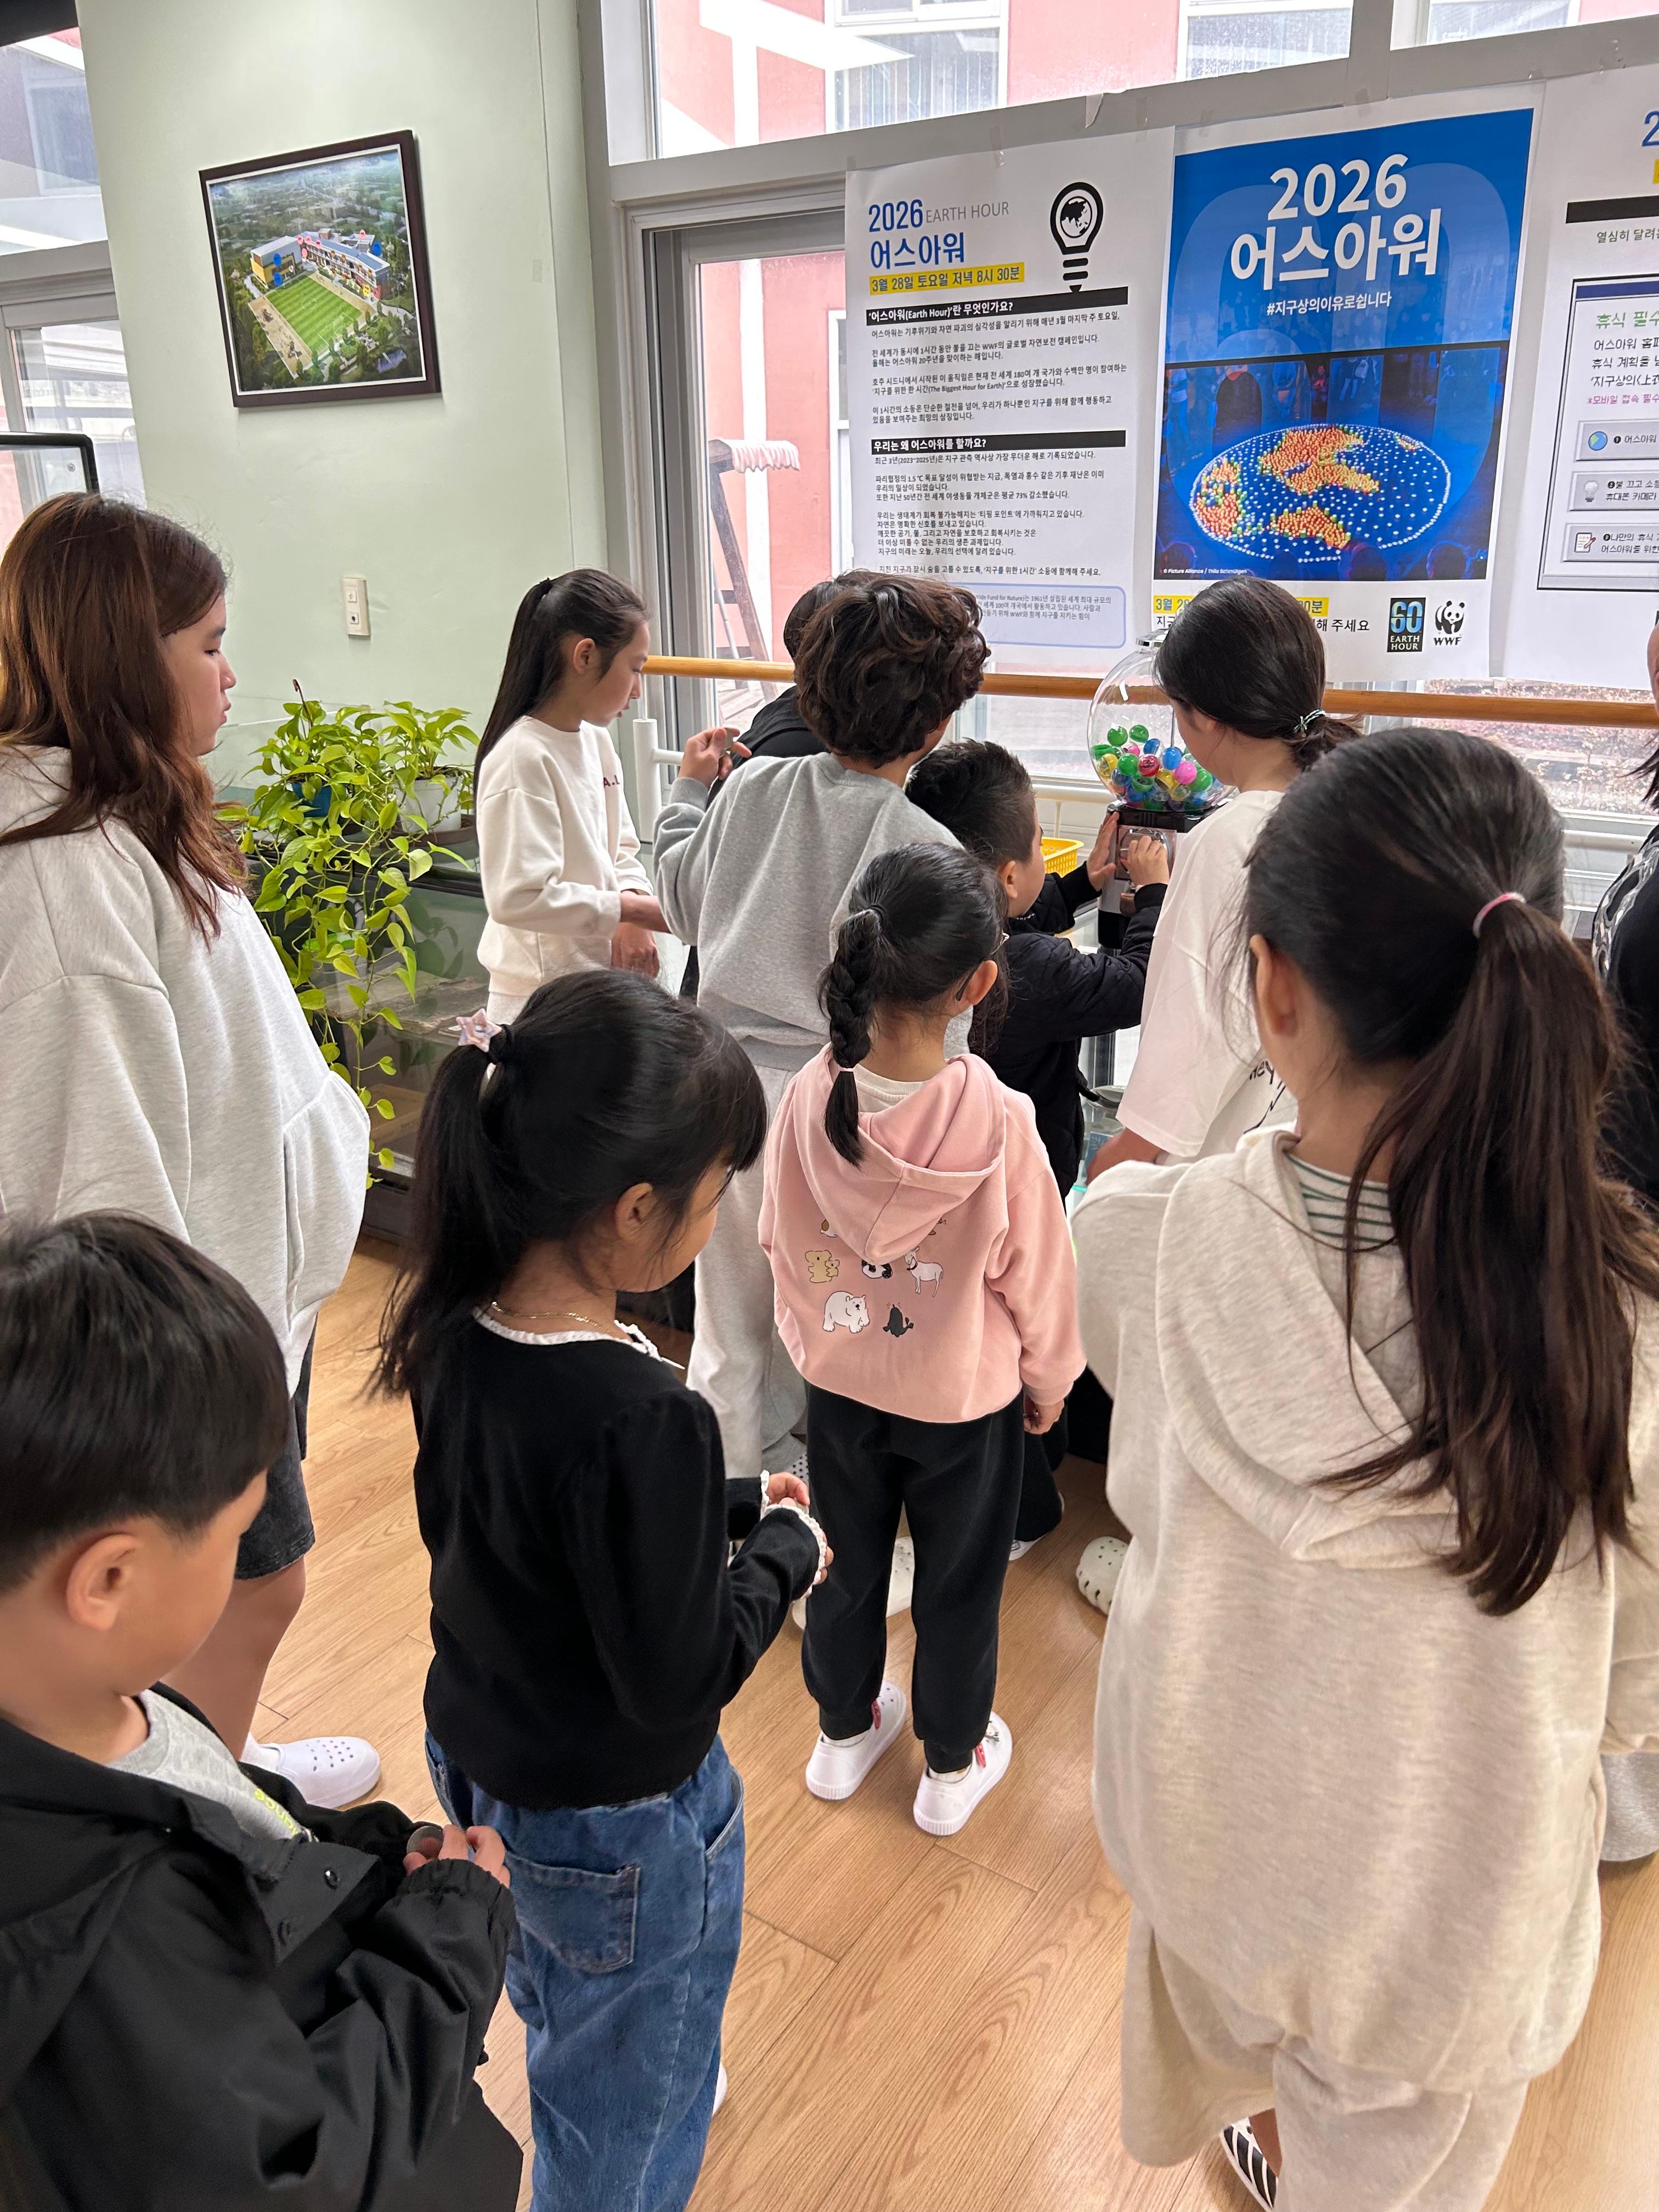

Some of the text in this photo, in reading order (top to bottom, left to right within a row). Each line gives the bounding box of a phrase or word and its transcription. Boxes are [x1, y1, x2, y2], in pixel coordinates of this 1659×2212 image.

[1268, 154, 1408, 221] 2026
[868, 199, 1009, 232] 2026 EARTH HOUR
[1597, 230, 1629, 243] 열심히
[871, 232, 964, 269] 어스아워
[1231, 208, 1442, 291] 어스아워
[872, 266, 1019, 291] 3월 28일 토요일 저녁 8시 30분
[963, 301, 1013, 315] 무엇인가요?
[1267, 291, 1392, 316] #지구상의이유로쉽니다
[871, 328, 903, 338] 어스아워는
[905, 325, 938, 336] 기후위기와
[939, 324, 951, 334] 자연
[974, 320, 1001, 331] 심각성을
[1003, 318, 1024, 329] 알리기
[1025, 318, 1039, 328] 위해
[1041, 316, 1054, 326] 매년
[1056, 315, 1065, 325] 3월
[1068, 313, 1088, 324] 마지막
[1088, 312, 1096, 323] 주
[1096, 311, 1119, 323] 토요일,
[1596, 312, 1626, 329] 휴식
[872, 349, 878, 358] 전
[879, 348, 899, 357] 세계가
[900, 346, 919, 356] 동시에
[920, 345, 937, 354] 1시간
[938, 344, 951, 353] 동안
[967, 342, 980, 351] 끄는
[982, 340, 1004, 349] WWF의
[1006, 339, 1026, 349] 글로벌
[1028, 336, 1056, 347] 자연보전
[1594, 338, 1637, 351] 어스아워
[892, 356, 917, 366] 어스아워
[918, 354, 945, 364] 20주년을
[974, 351, 1003, 361] 해입니다.
[1592, 357, 1612, 369] 휴식
[1617, 356, 1650, 368] 계획을
[872, 377, 884, 386] 호주
[918, 374, 938, 383] 시작된
[939, 374, 946, 382] 이
[975, 371, 989, 381] 현재
[990, 371, 996, 380] 전
[998, 370, 1012, 379] 세계
[1013, 369, 1031, 378] 180여
[1032, 368, 1040, 377] 개
[1041, 367, 1062, 377] 국가와
[1063, 365, 1084, 376] 수백만
[1085, 364, 1098, 374] 명이
[1100, 363, 1127, 373] 참여하는
[894, 385, 906, 394] 위한
[907, 385, 914, 394] 한
[1622, 394, 1639, 404] 접속
[892, 414, 917, 423] 보여주는
[873, 437, 986, 452] 우리는 왜 어스아워를 할까요?
[1624, 435, 1656, 443] 어스아워
[874, 456, 887, 465] 최근
[945, 454, 958, 463] 지구
[958, 454, 972, 463] 관측
[974, 453, 994, 462] 역사상
[995, 453, 1009, 461] 가장
[1010, 452, 1030, 461] 무더운
[1031, 452, 1045, 460] 해로
[876, 484, 894, 492] 우리의
[895, 483, 914, 492] 일상이
[889, 493, 902, 501] 지난
[923, 492, 930, 500] 전
[931, 492, 944, 500] 세계
[1001, 491, 1014, 499] 평균
[1633, 492, 1656, 501] 카메라
[1156, 599, 1172, 611] 3월
[1391, 601, 1423, 633] 60
[1331, 619, 1369, 632] 주세요
[1434, 637, 1462, 646] WWF
